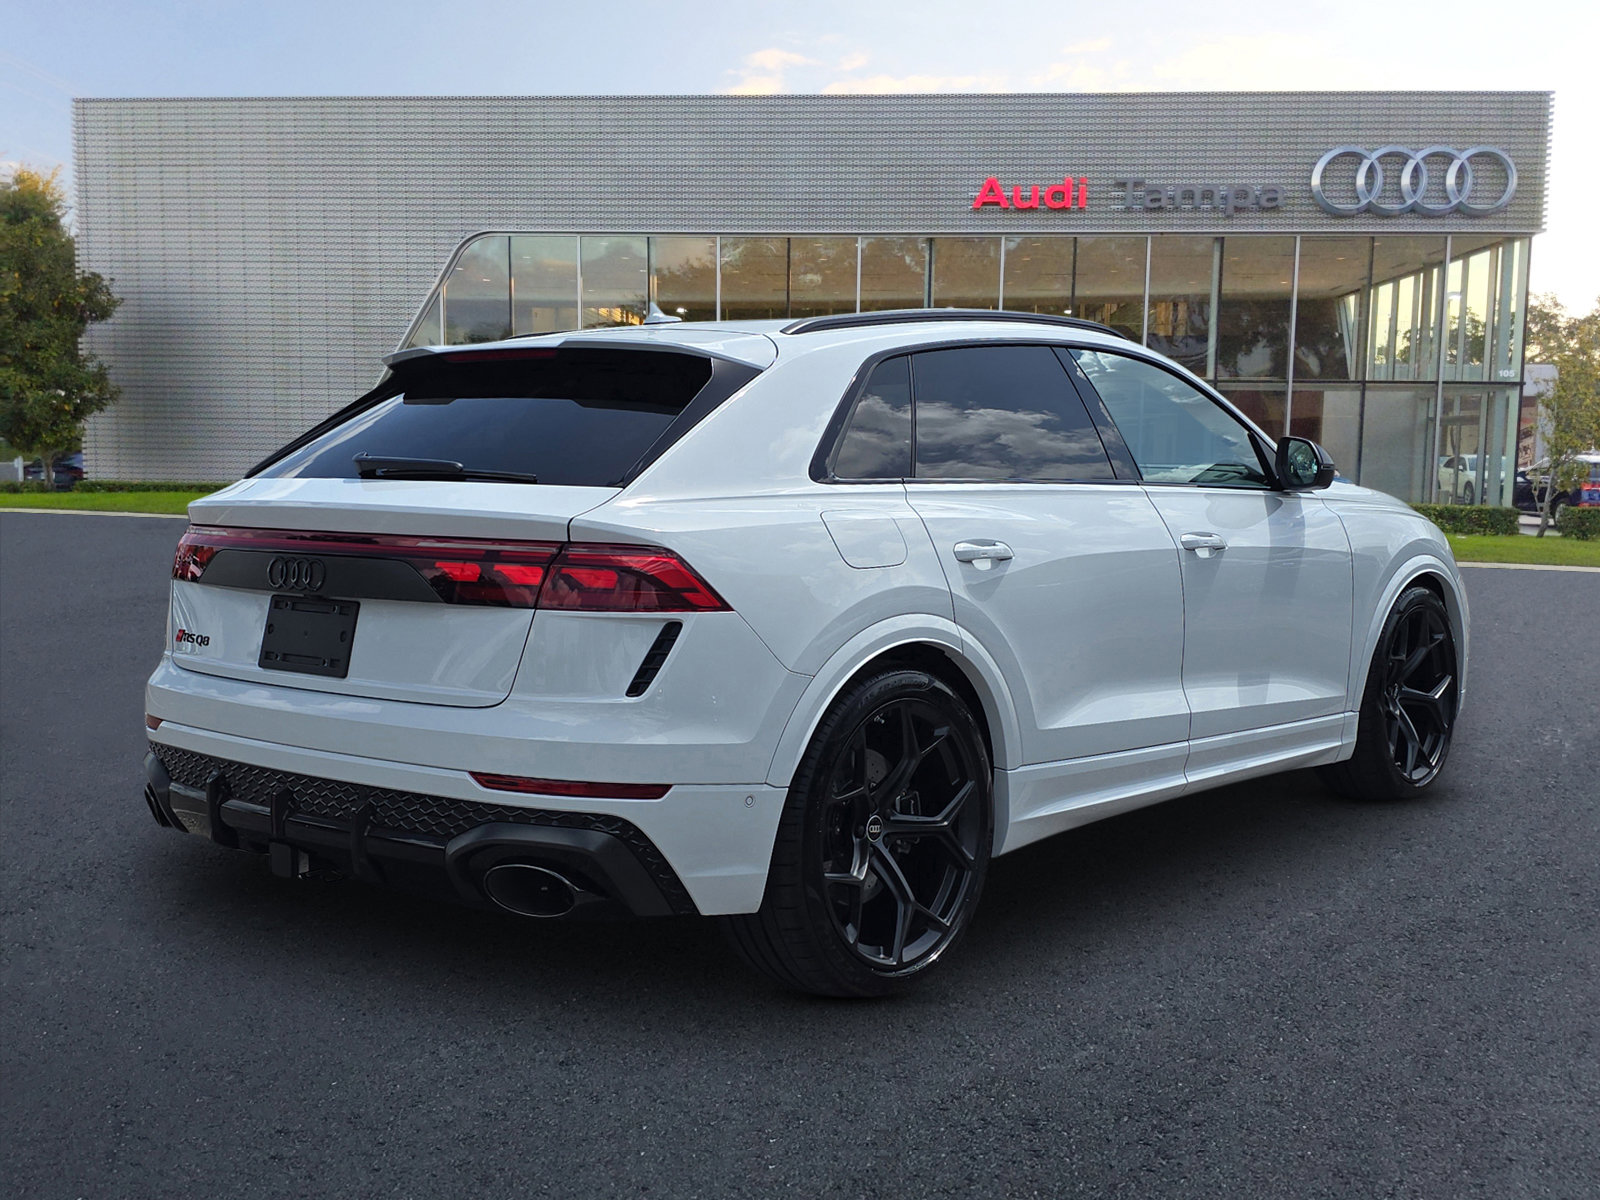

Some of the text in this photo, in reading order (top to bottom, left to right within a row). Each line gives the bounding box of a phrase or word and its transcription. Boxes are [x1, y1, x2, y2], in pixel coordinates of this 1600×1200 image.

[972, 177, 1287, 218] Audi Tampa
[1498, 369, 1515, 378] 105
